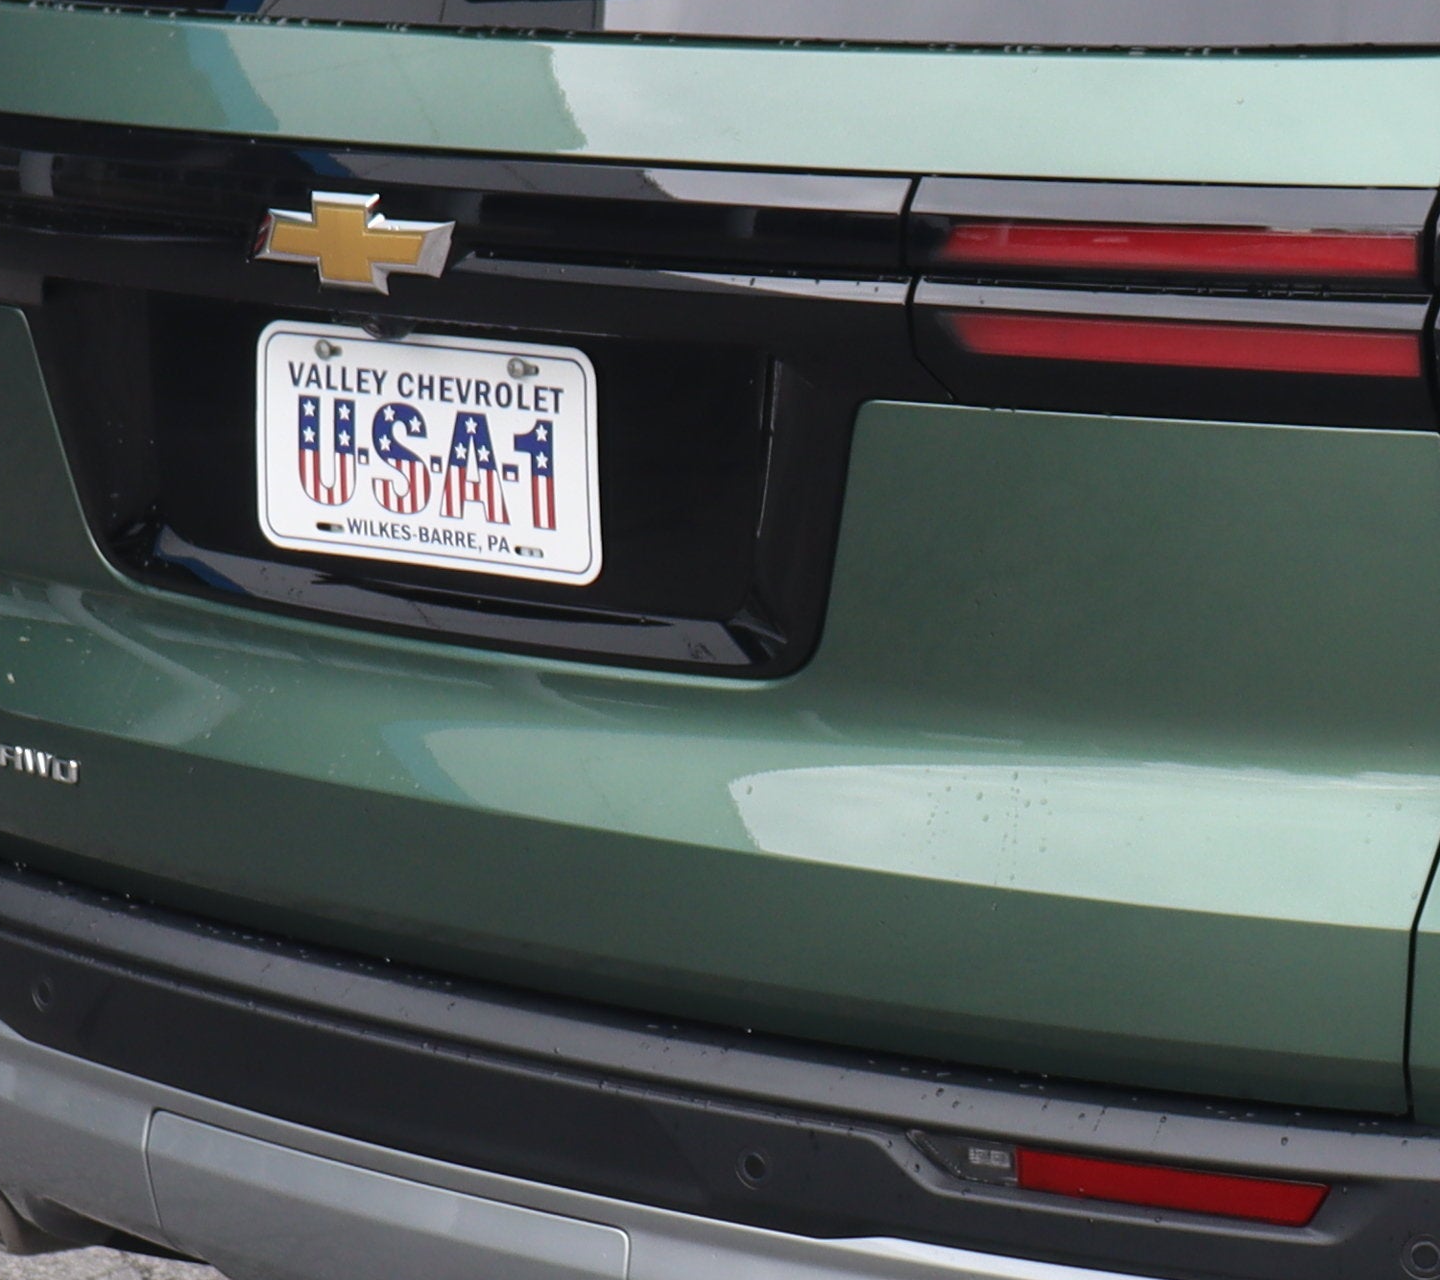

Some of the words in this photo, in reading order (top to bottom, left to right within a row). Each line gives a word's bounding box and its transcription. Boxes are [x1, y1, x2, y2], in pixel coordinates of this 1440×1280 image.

[287, 360, 388, 397] VALLEY
[396, 371, 565, 415] CHEVROLET
[346, 517, 483, 554] WILKES-BARRE,
[487, 535, 511, 555] PA
